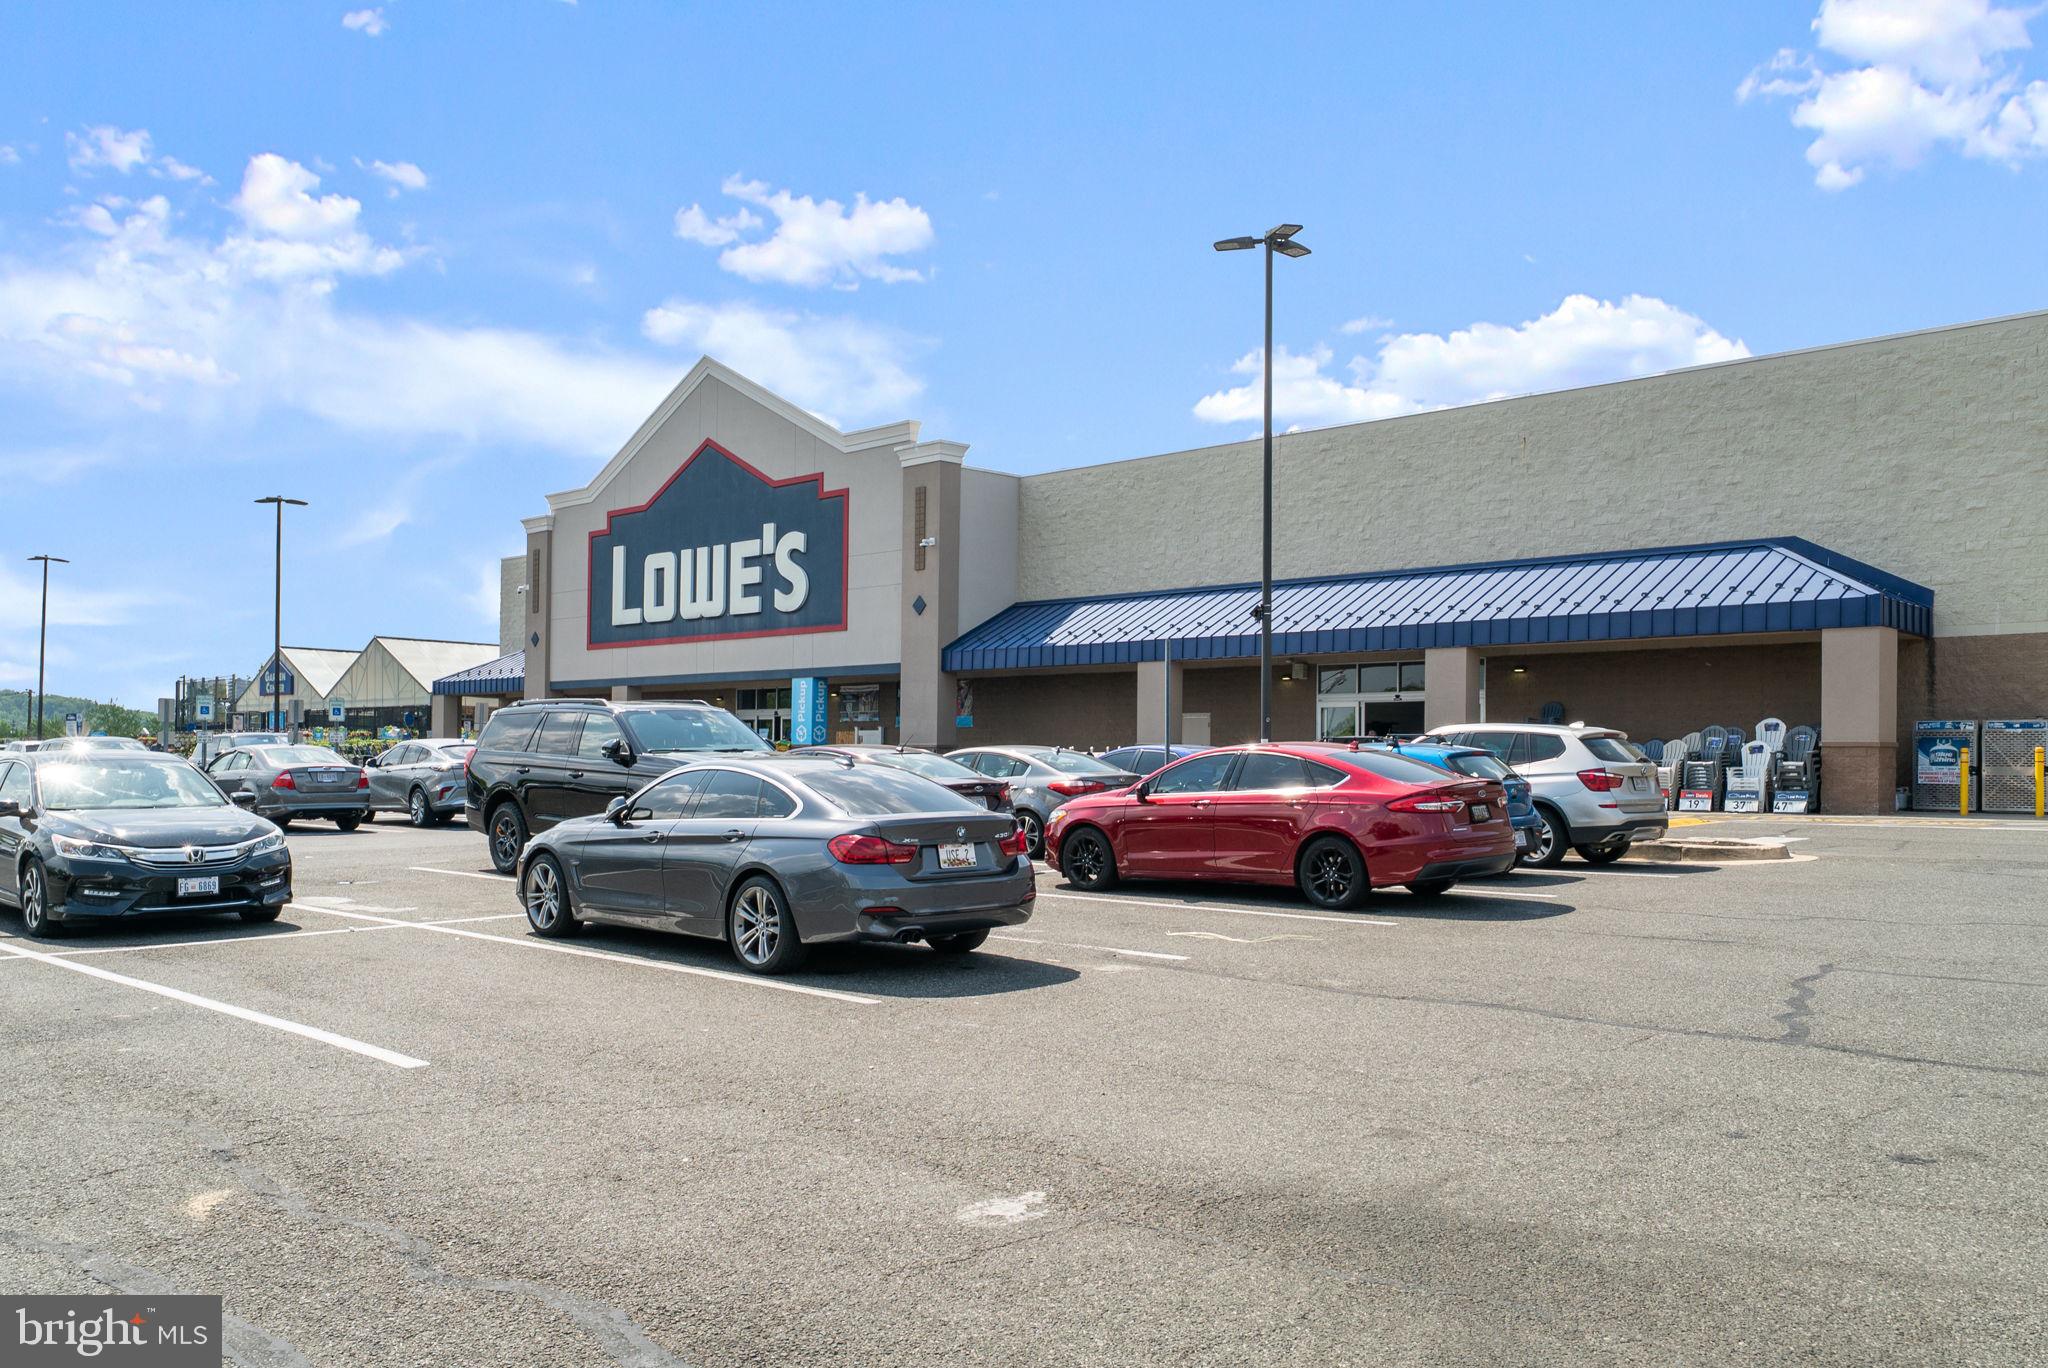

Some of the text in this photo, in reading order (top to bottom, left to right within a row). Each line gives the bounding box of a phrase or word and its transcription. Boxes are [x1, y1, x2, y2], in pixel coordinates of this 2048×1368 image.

[611, 522, 809, 626] LOWE'S
[797, 680, 808, 722] Pickup
[815, 680, 827, 722] Pickup
[198, 880, 217, 891] 6869
